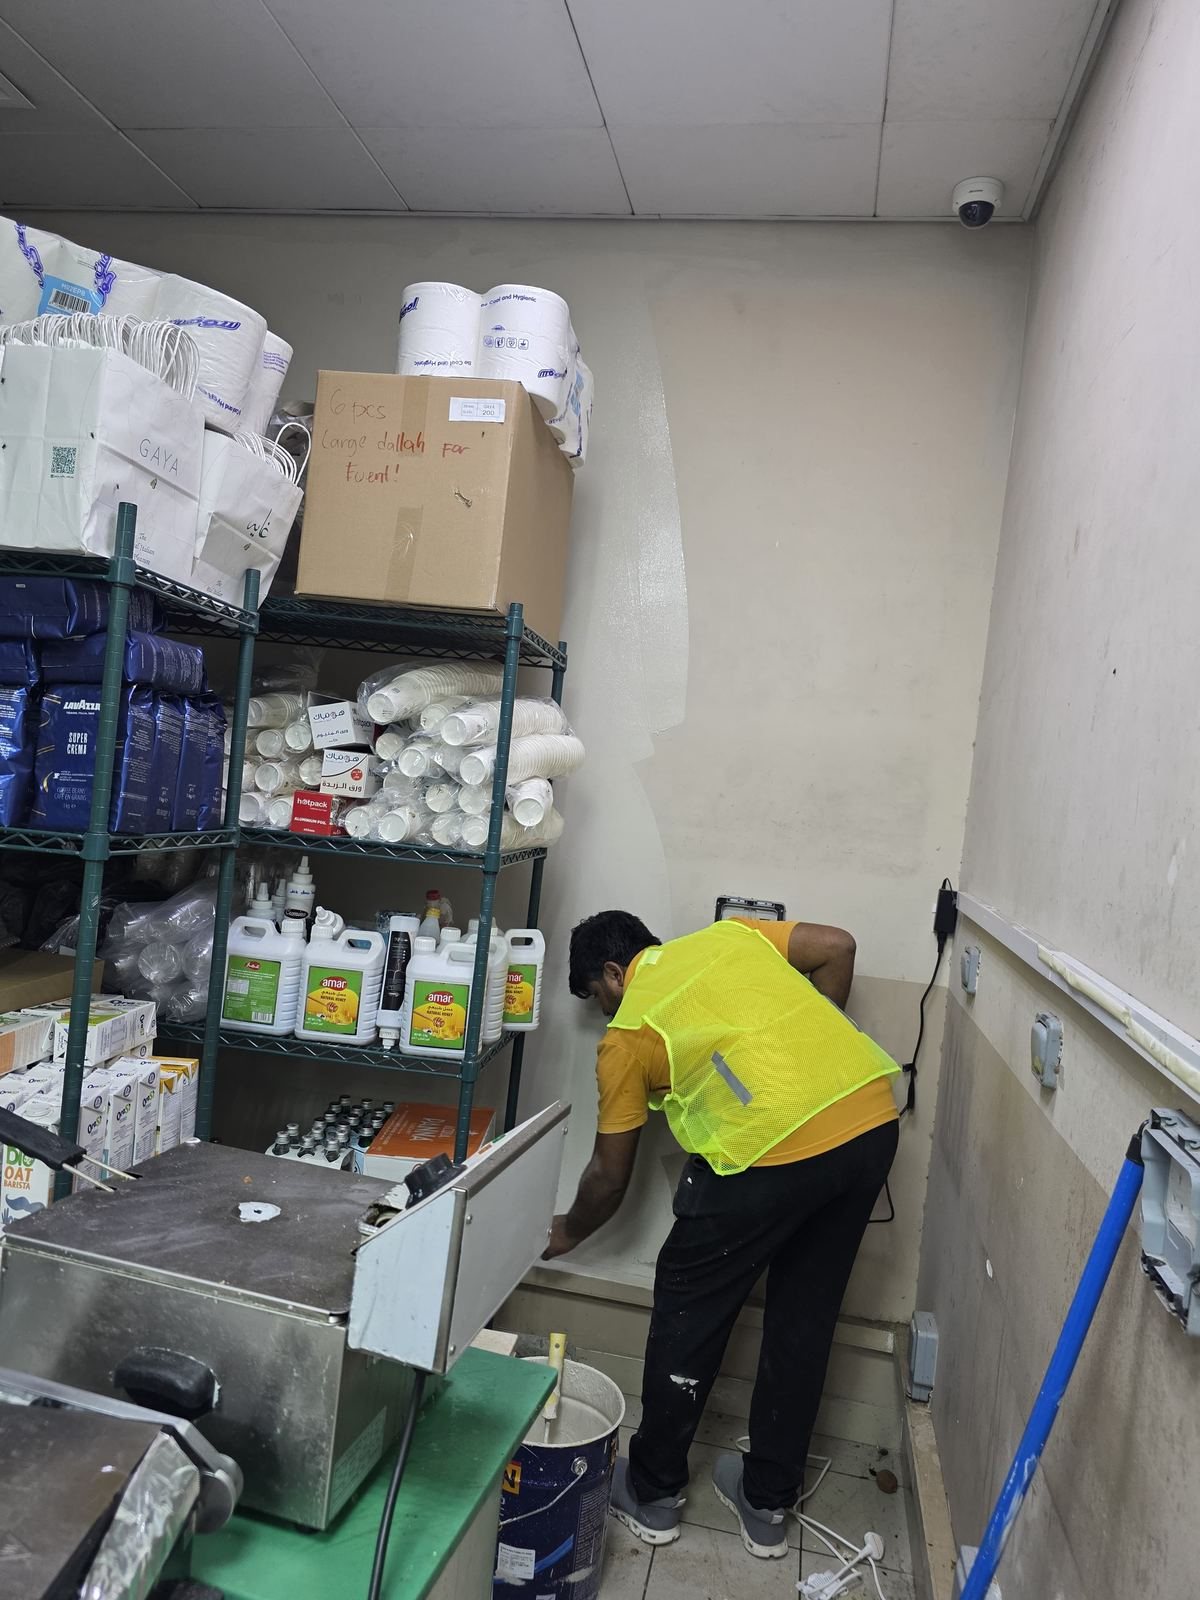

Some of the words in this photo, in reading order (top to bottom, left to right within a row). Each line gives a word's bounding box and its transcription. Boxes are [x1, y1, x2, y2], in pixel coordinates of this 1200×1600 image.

[330, 388, 345, 414] 6
[351, 401, 386, 424] pcs
[139, 438, 178, 476] GAYA
[68, 732, 88, 744] SUPER
[66, 744, 87, 754] CREMA
[296, 798, 328, 808] hotpack
[322, 978, 346, 989] amar
[428, 994, 453, 1004] amar
[4, 1166, 33, 1182] OAT
[4, 1179, 30, 1190] BARISTA
